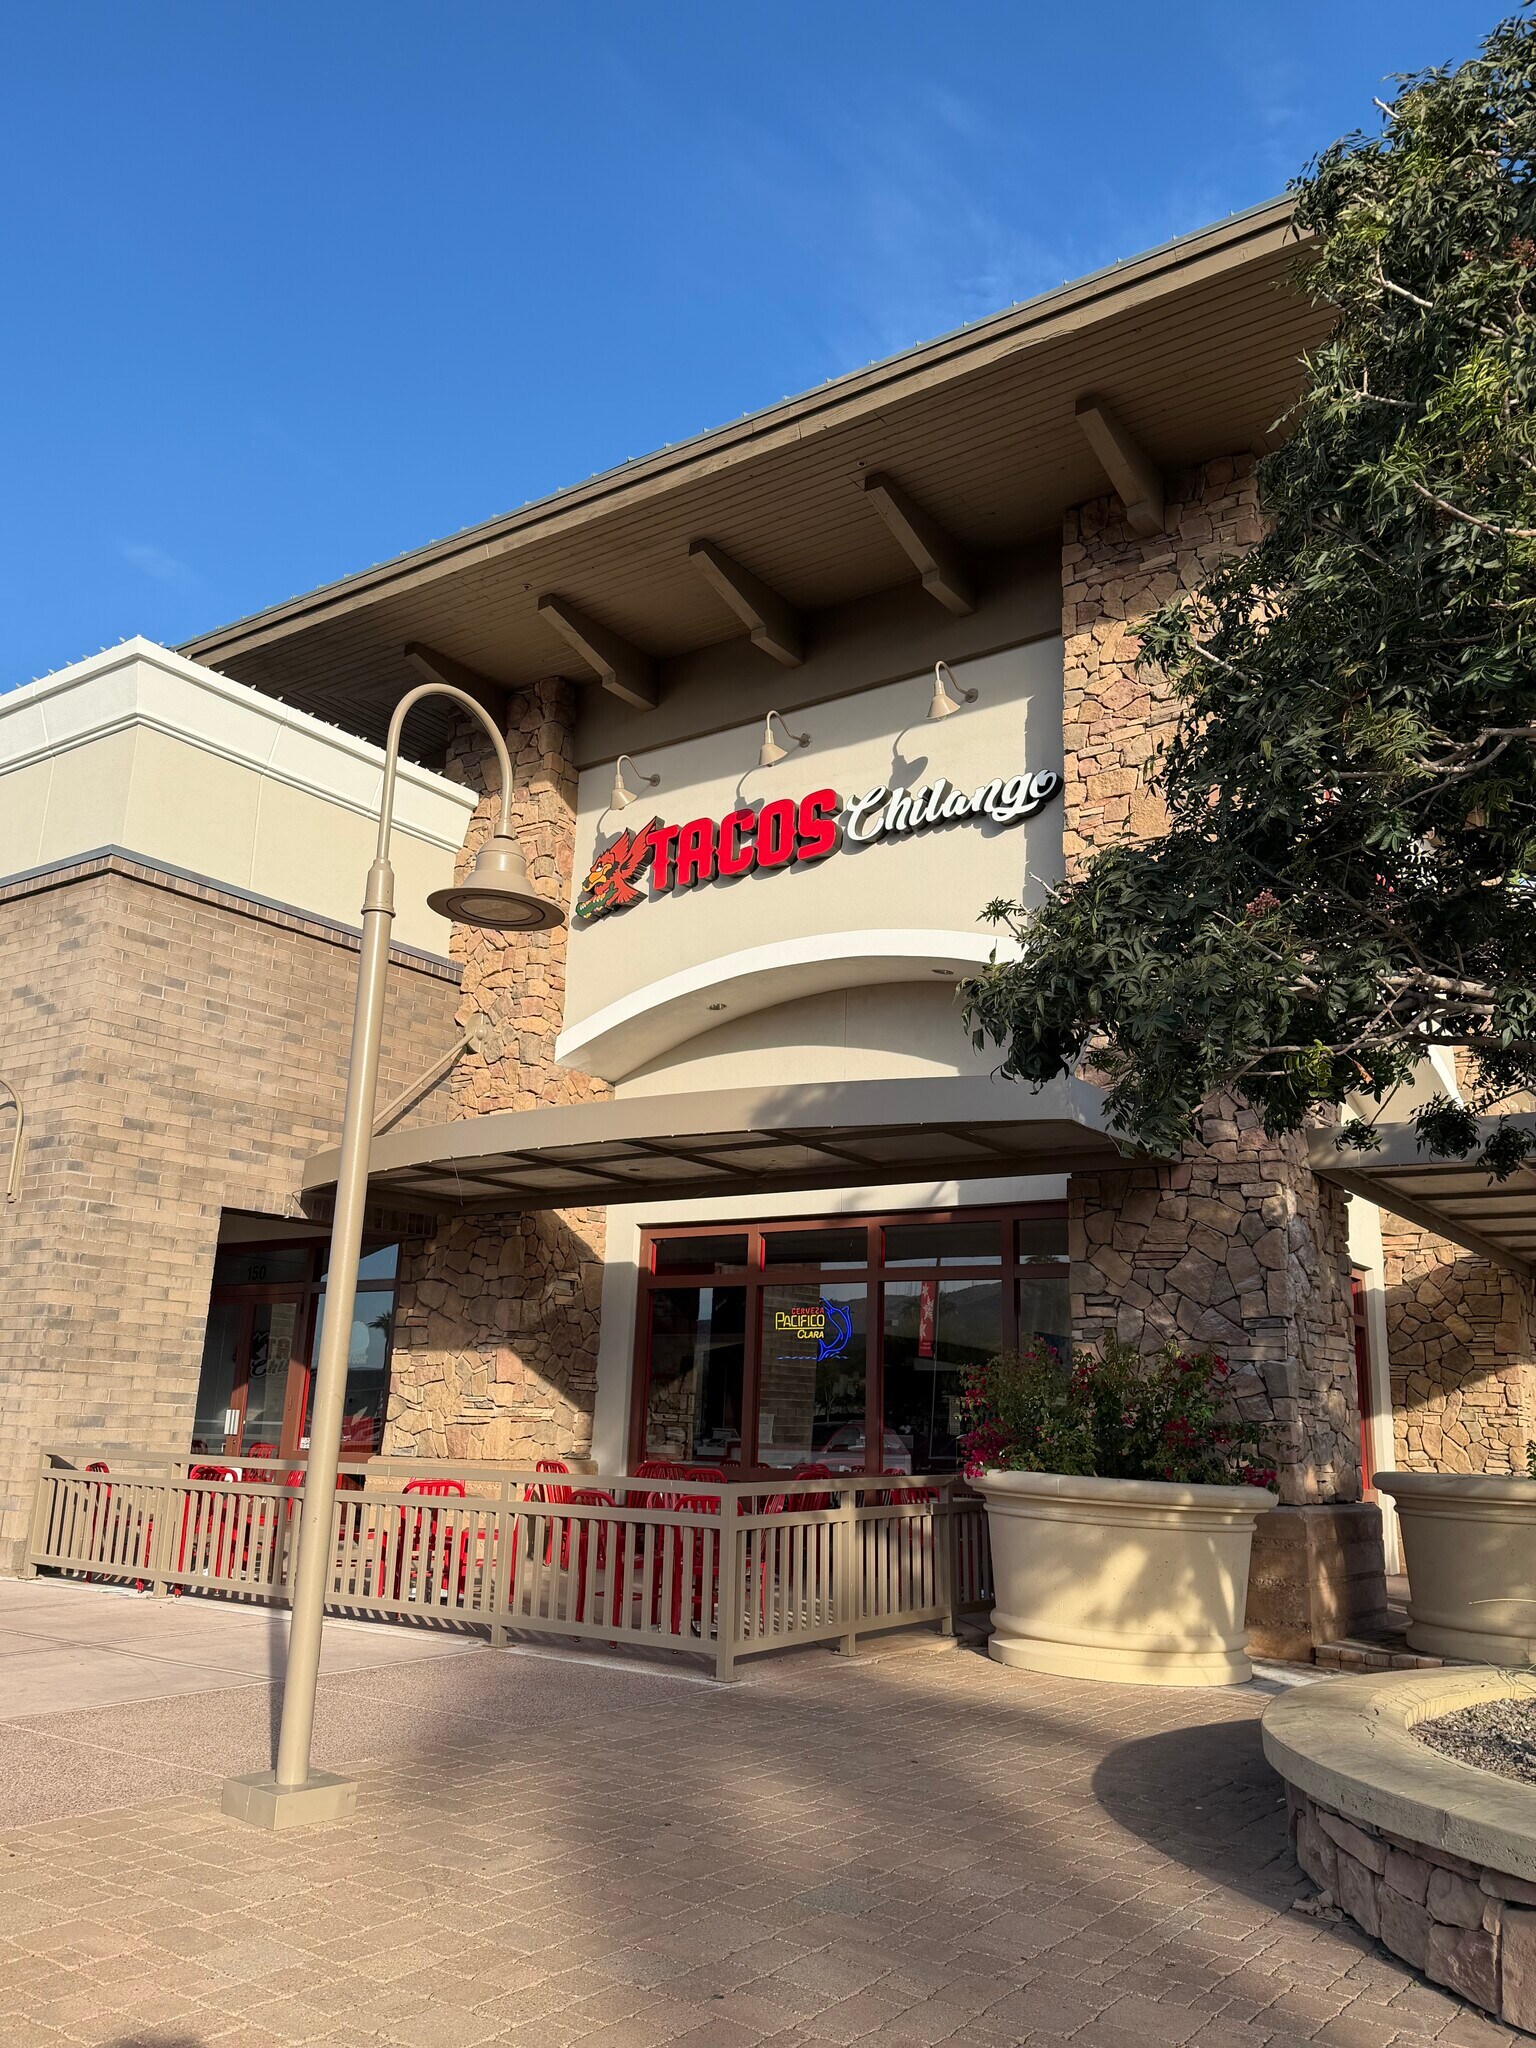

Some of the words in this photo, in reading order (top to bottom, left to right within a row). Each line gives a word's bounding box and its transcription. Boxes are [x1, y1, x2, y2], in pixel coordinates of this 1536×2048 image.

[646, 788, 841, 891] TACOS
[846, 769, 1060, 842] Chilango
[248, 1264, 267, 1280] 150
[791, 1307, 825, 1315] CERVEZA
[775, 1311, 825, 1330] PACIFICO
[797, 1329, 824, 1339] CLARA
